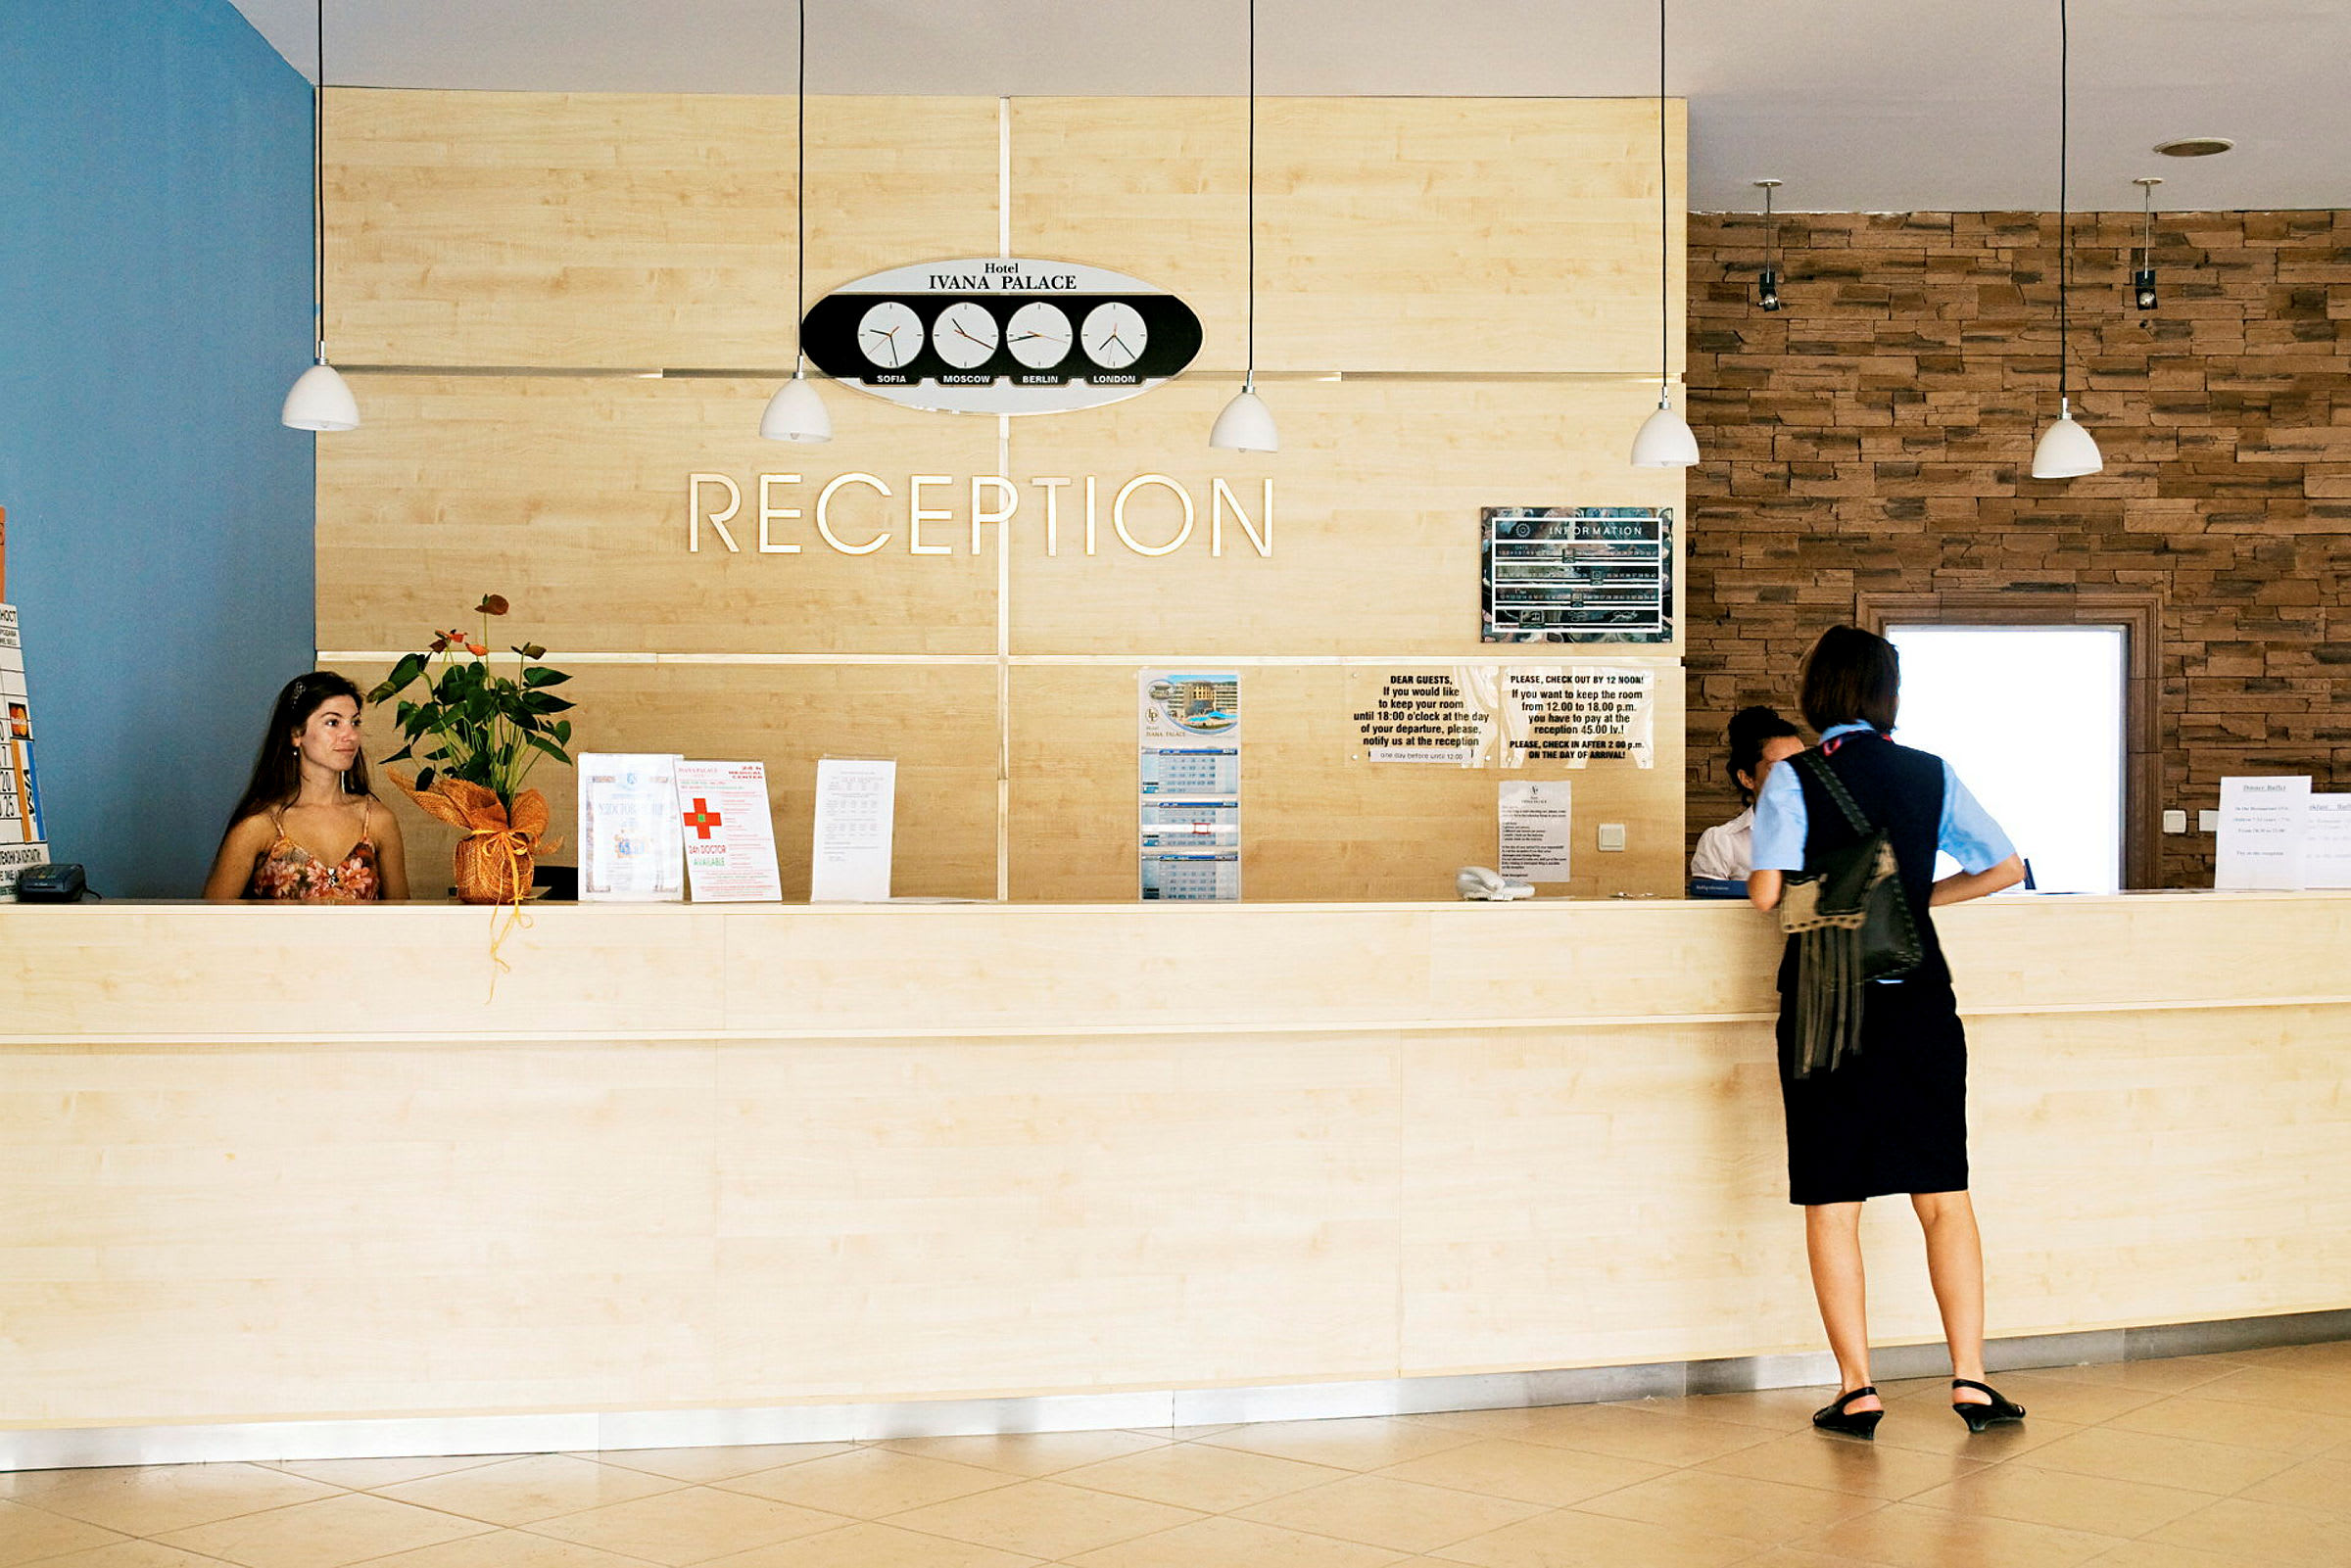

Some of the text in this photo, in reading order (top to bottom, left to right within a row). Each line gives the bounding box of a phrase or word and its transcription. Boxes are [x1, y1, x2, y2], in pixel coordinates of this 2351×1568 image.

[984, 263, 1019, 273] Hotel
[930, 275, 1077, 290] IVANA PALACE
[687, 472, 1272, 558] RECEPTION
[1416, 676, 1452, 685] GUESTS,
[1383, 687, 1460, 697] If you would like
[1512, 689, 1518, 698] If
[1577, 690, 1598, 700] keep
[1379, 699, 1387, 708] to
[1391, 699, 1413, 710] keep
[1415, 701, 1436, 710] your
[1522, 702, 1543, 711] from
[1547, 702, 1573, 711] 12.00
[1588, 702, 1613, 711] 18.00
[1617, 704, 1636, 713] p.m.
[1354, 712, 1373, 721] until
[1408, 712, 1439, 721] o'clock
[1455, 712, 1469, 721] the
[1472, 712, 1489, 722] day
[1361, 724, 1481, 735] of your departure, please,
[1535, 725, 1578, 736] reception
[1364, 736, 1389, 746] notify
[1406, 736, 1415, 745] at
[1418, 736, 1432, 745] the
[1435, 736, 1479, 747] reception
[700, 845, 726, 854] DOCTOR
[694, 857, 724, 866] AVAILABLE
